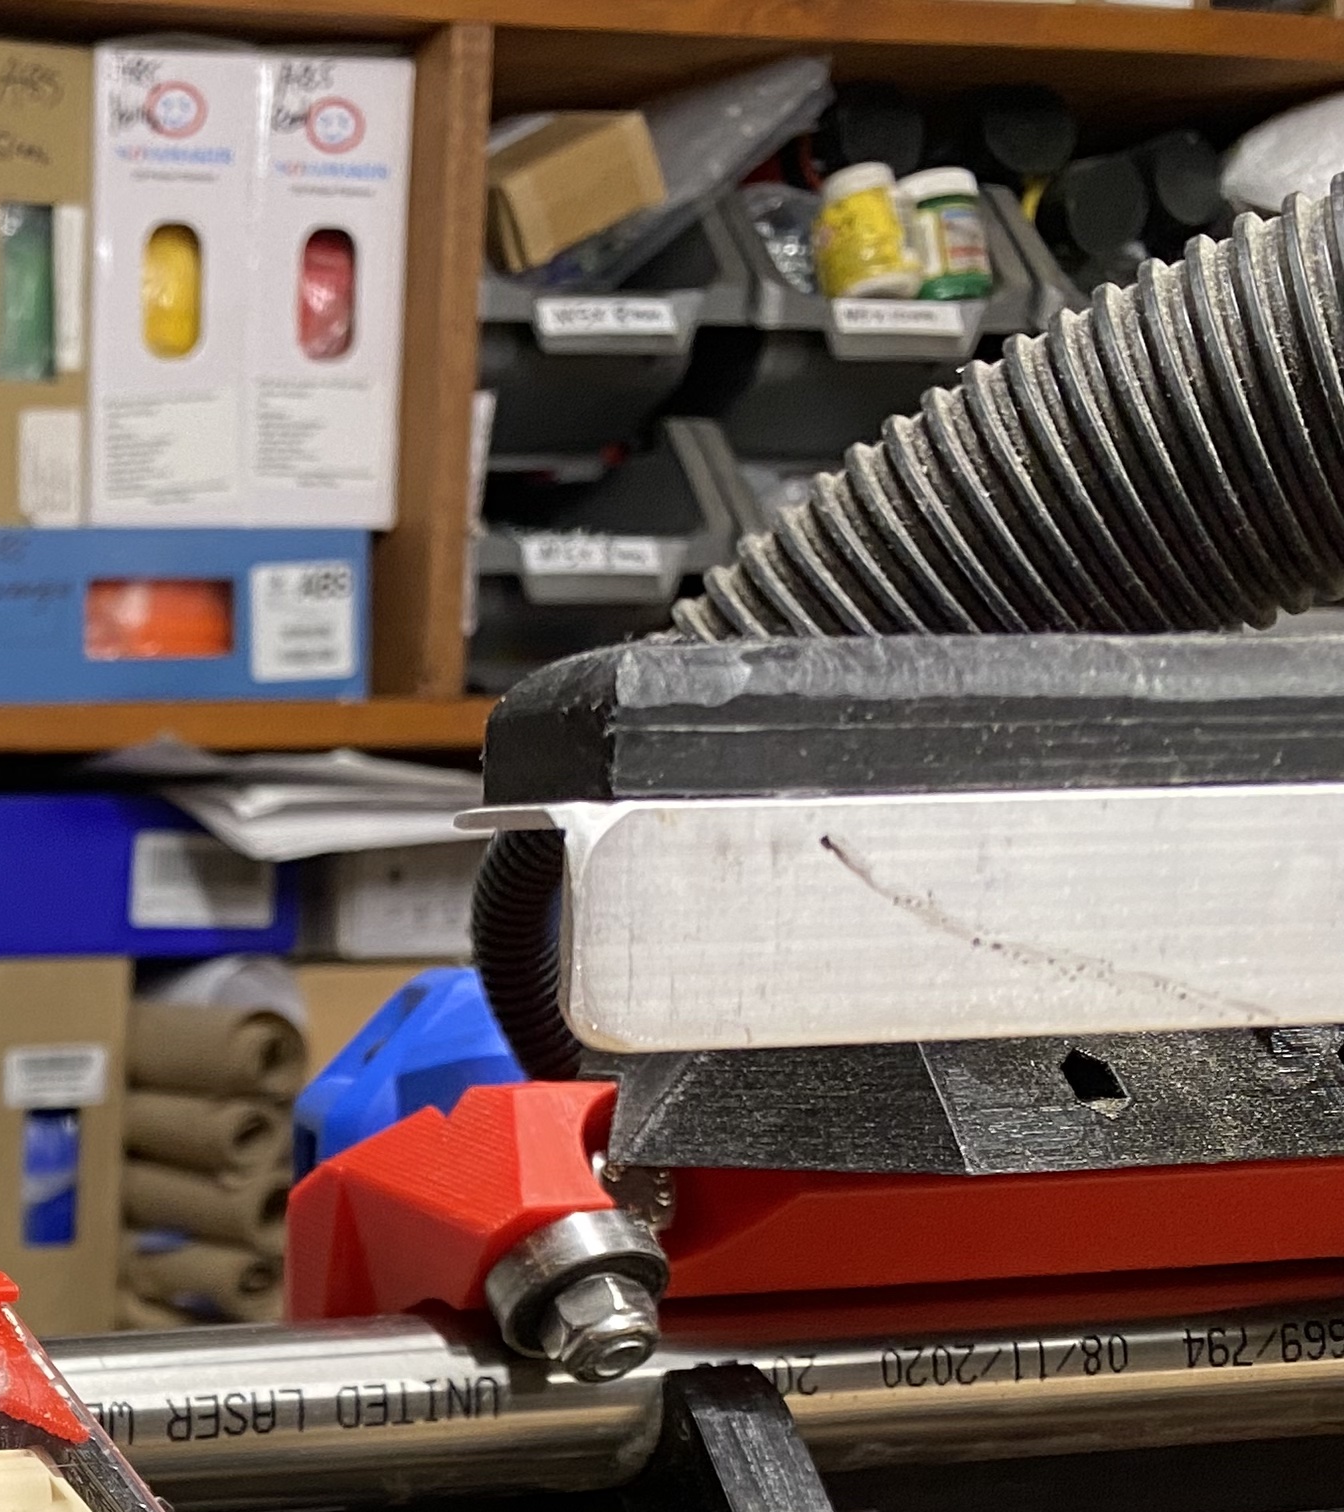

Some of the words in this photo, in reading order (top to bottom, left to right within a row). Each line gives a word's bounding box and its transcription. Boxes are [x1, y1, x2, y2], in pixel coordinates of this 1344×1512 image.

[879, 1332, 1130, 1388] 08/11/2020
[165, 1387, 306, 1443] LASER
[334, 1375, 500, 1429] UNITED
